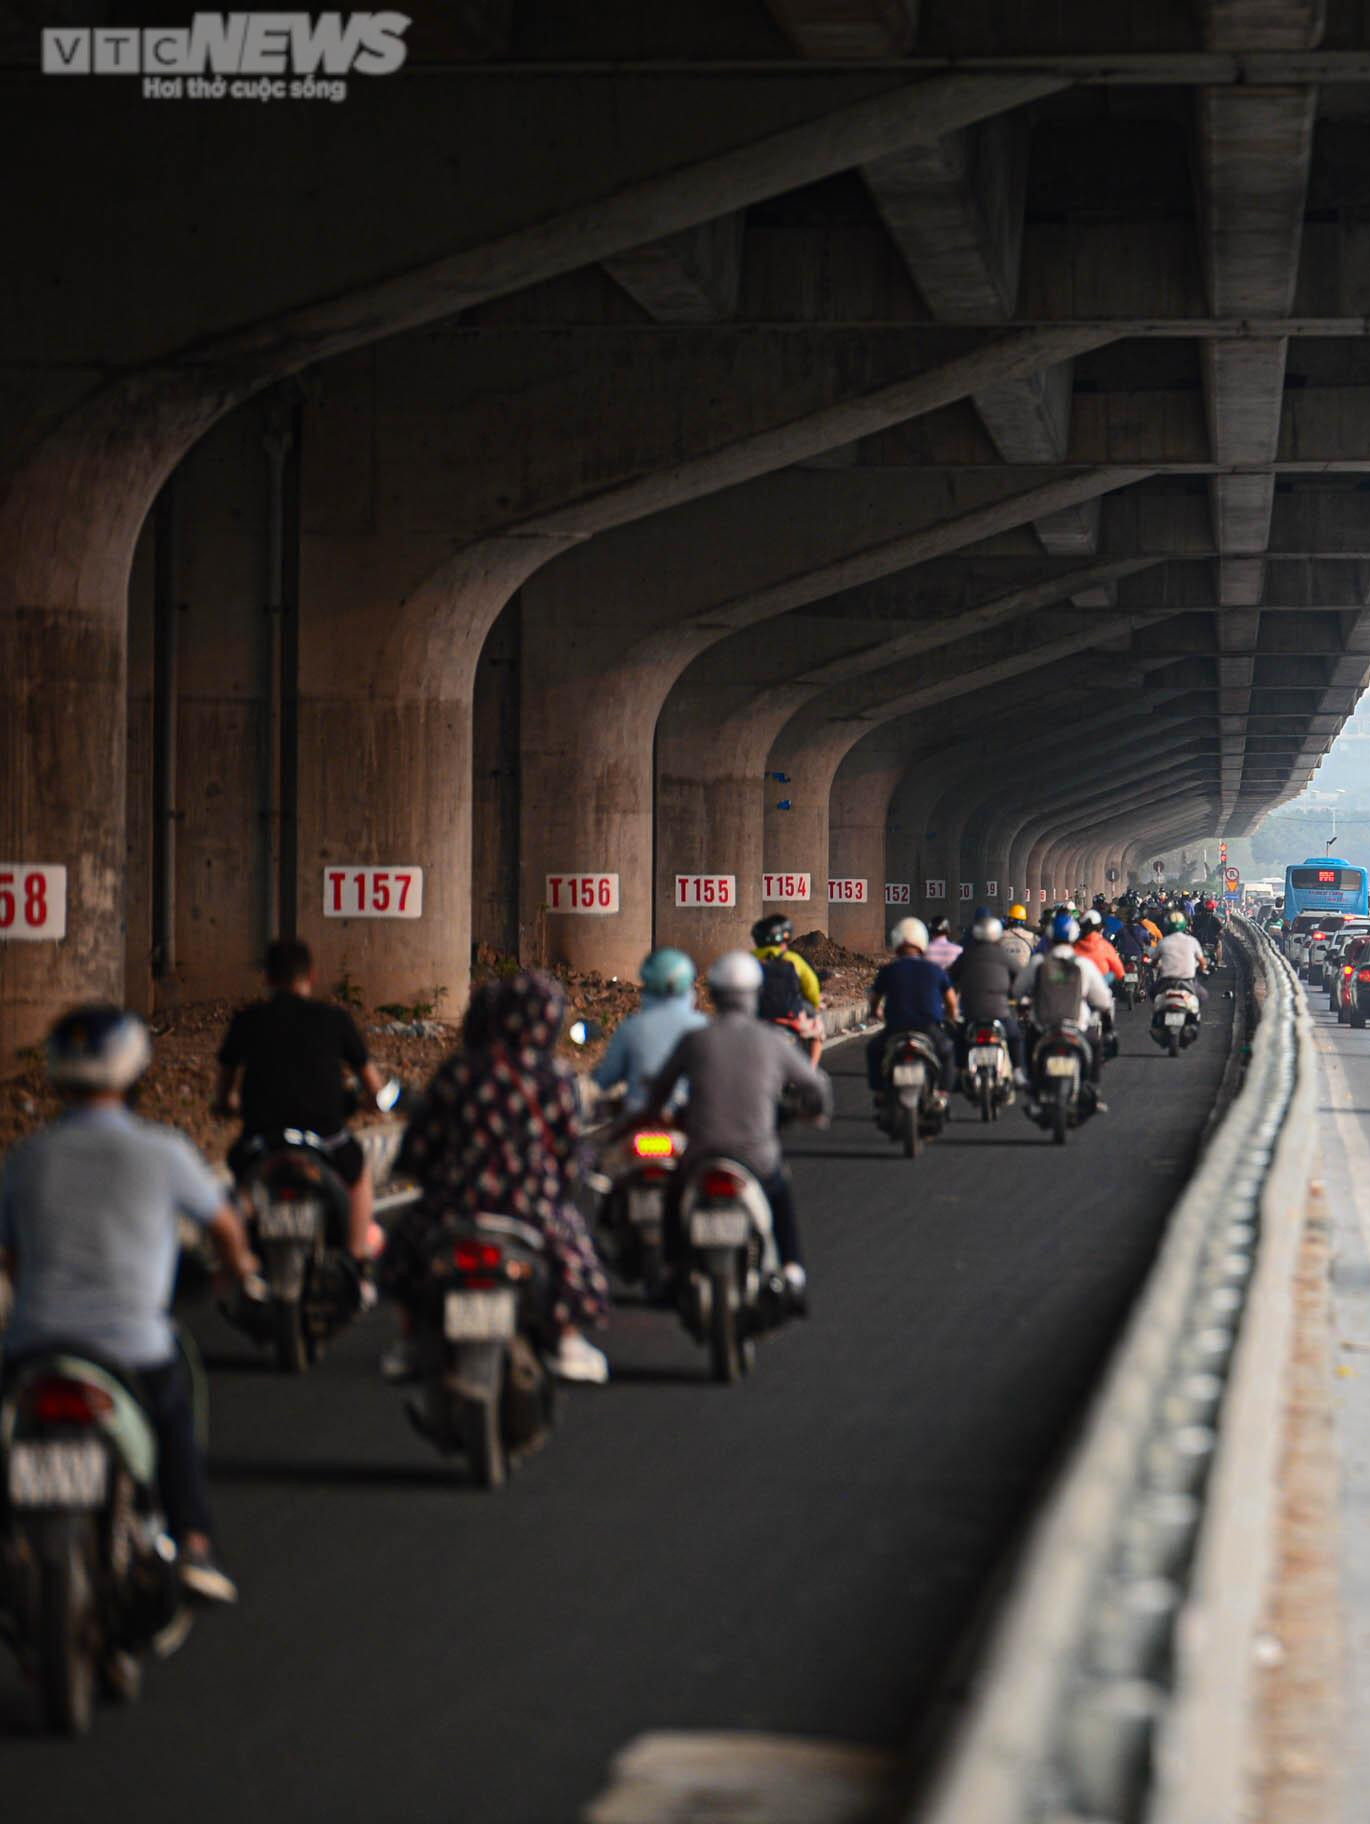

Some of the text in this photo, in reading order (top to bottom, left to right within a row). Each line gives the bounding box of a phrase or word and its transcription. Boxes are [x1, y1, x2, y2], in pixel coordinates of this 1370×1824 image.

[329, 872, 412, 912] T157
[550, 878, 611, 908] T156
[678, 878, 729, 903] T155
[764, 876, 806, 896] T154
[828, 881, 863, 899] T153
